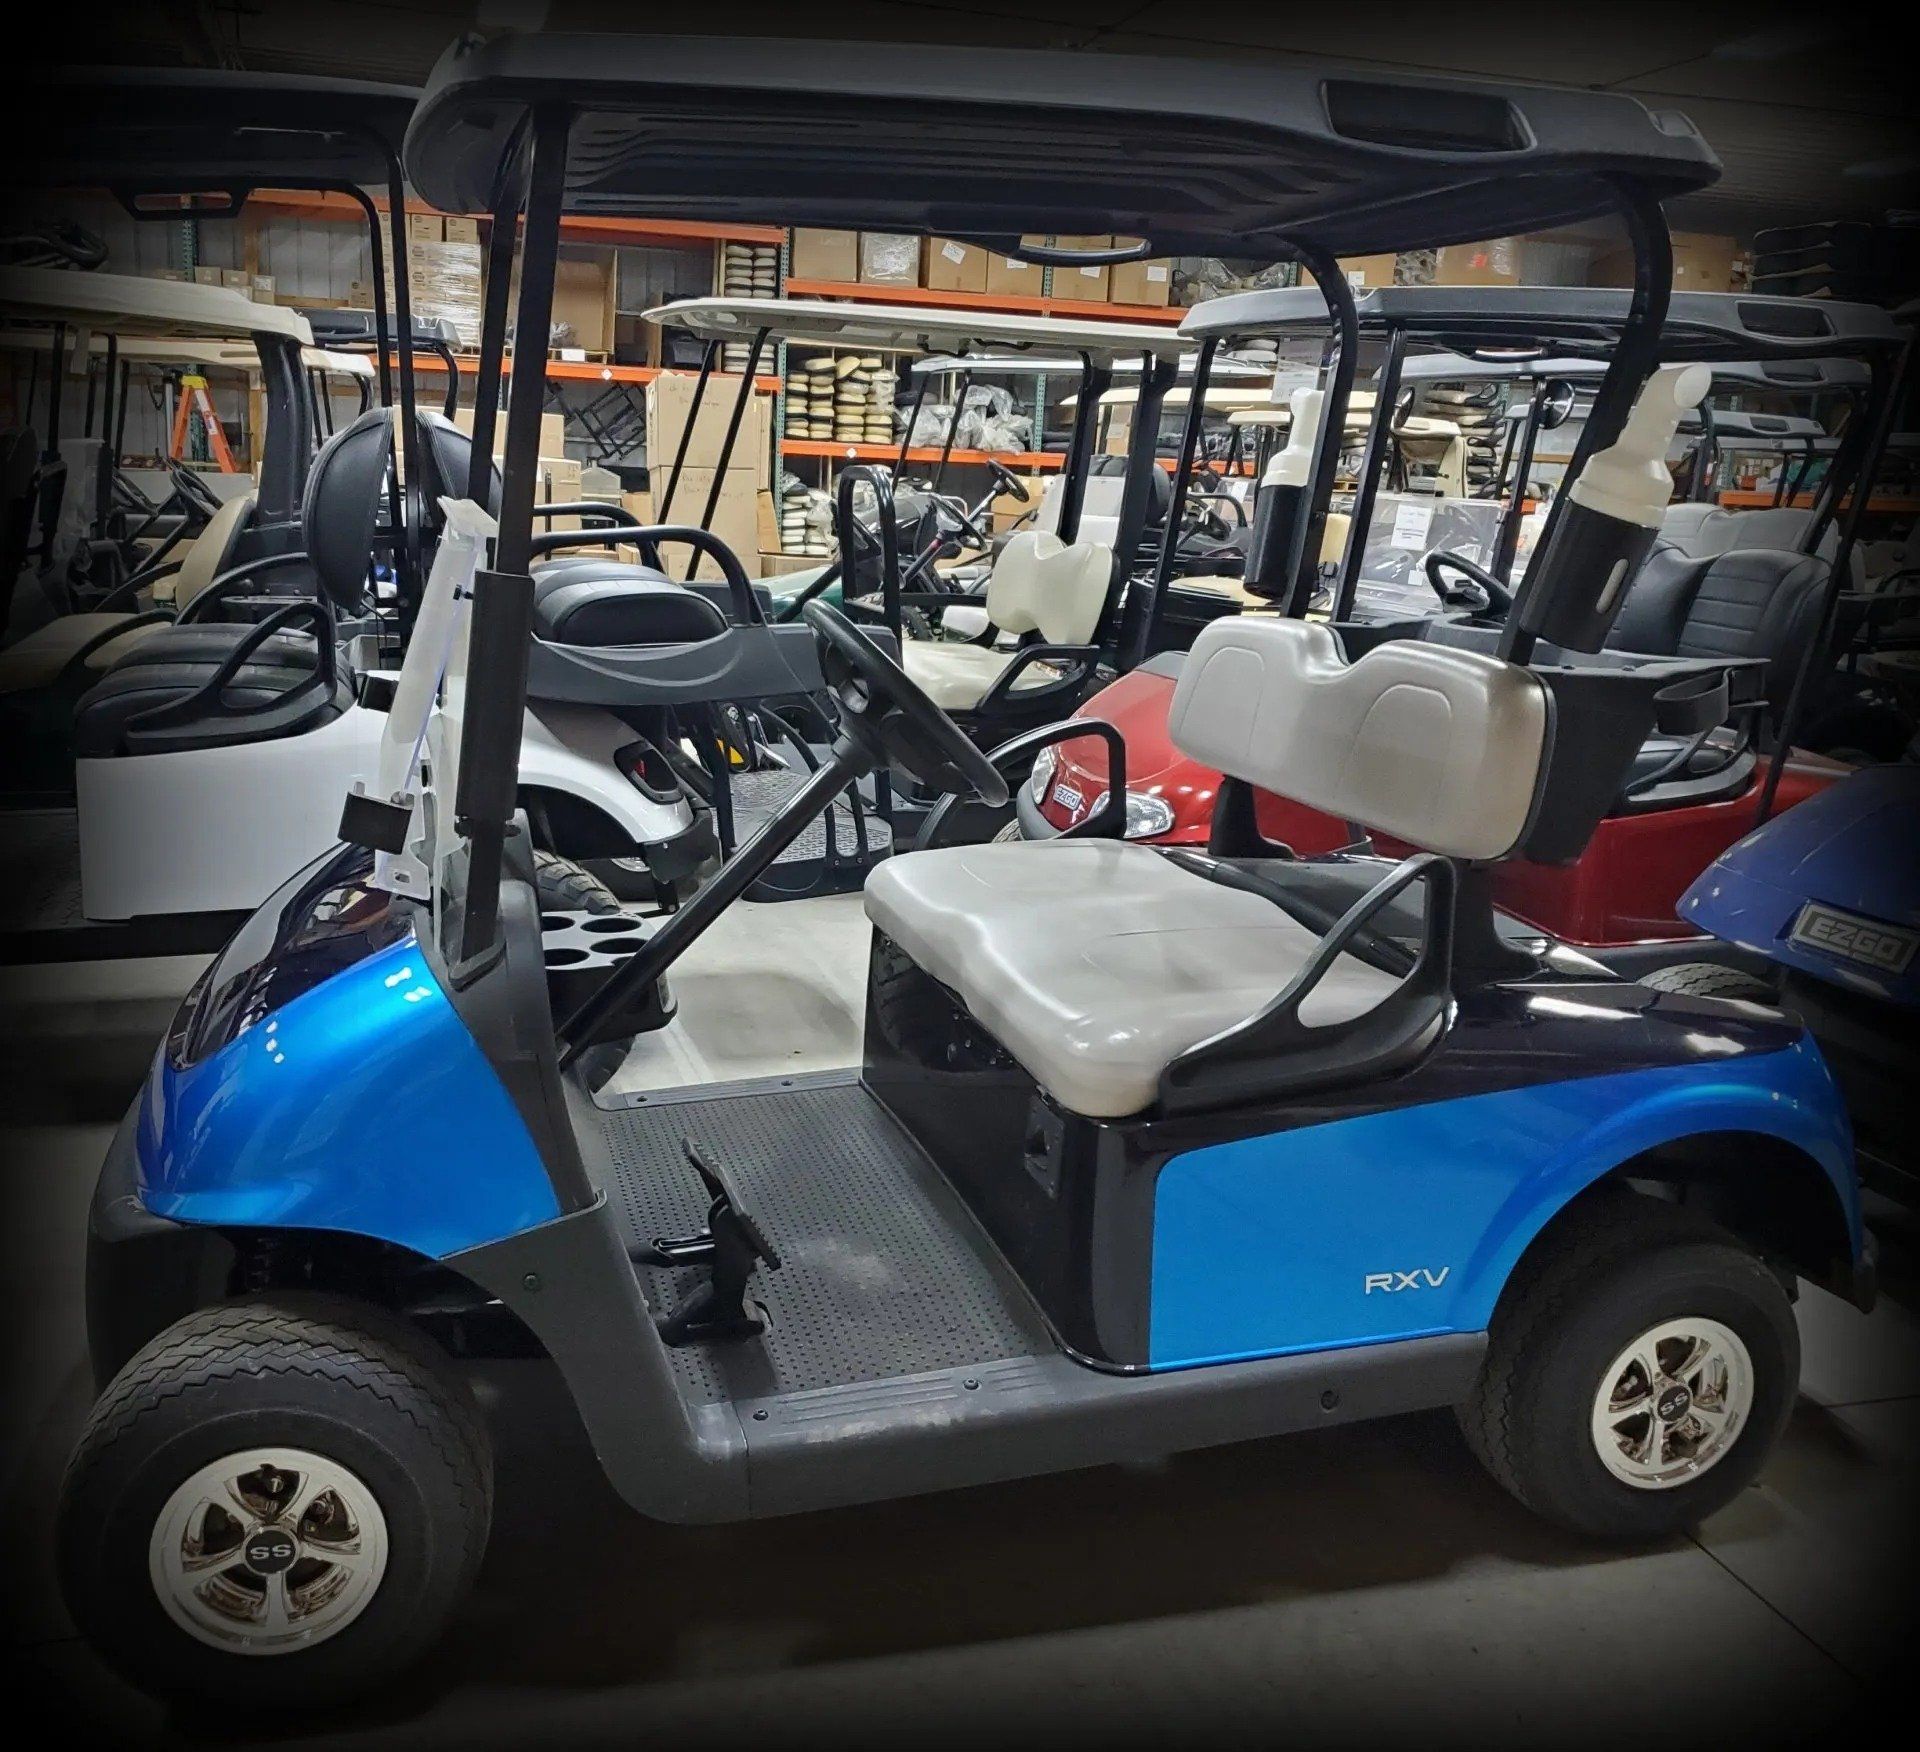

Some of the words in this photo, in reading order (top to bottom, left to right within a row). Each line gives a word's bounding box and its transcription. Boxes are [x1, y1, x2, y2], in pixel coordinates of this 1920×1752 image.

[1809, 916, 1904, 961] EZGO
[1365, 1266, 1450, 1295] RXV
[1660, 1392, 1688, 1416] SS
[250, 1544, 291, 1560] SS
